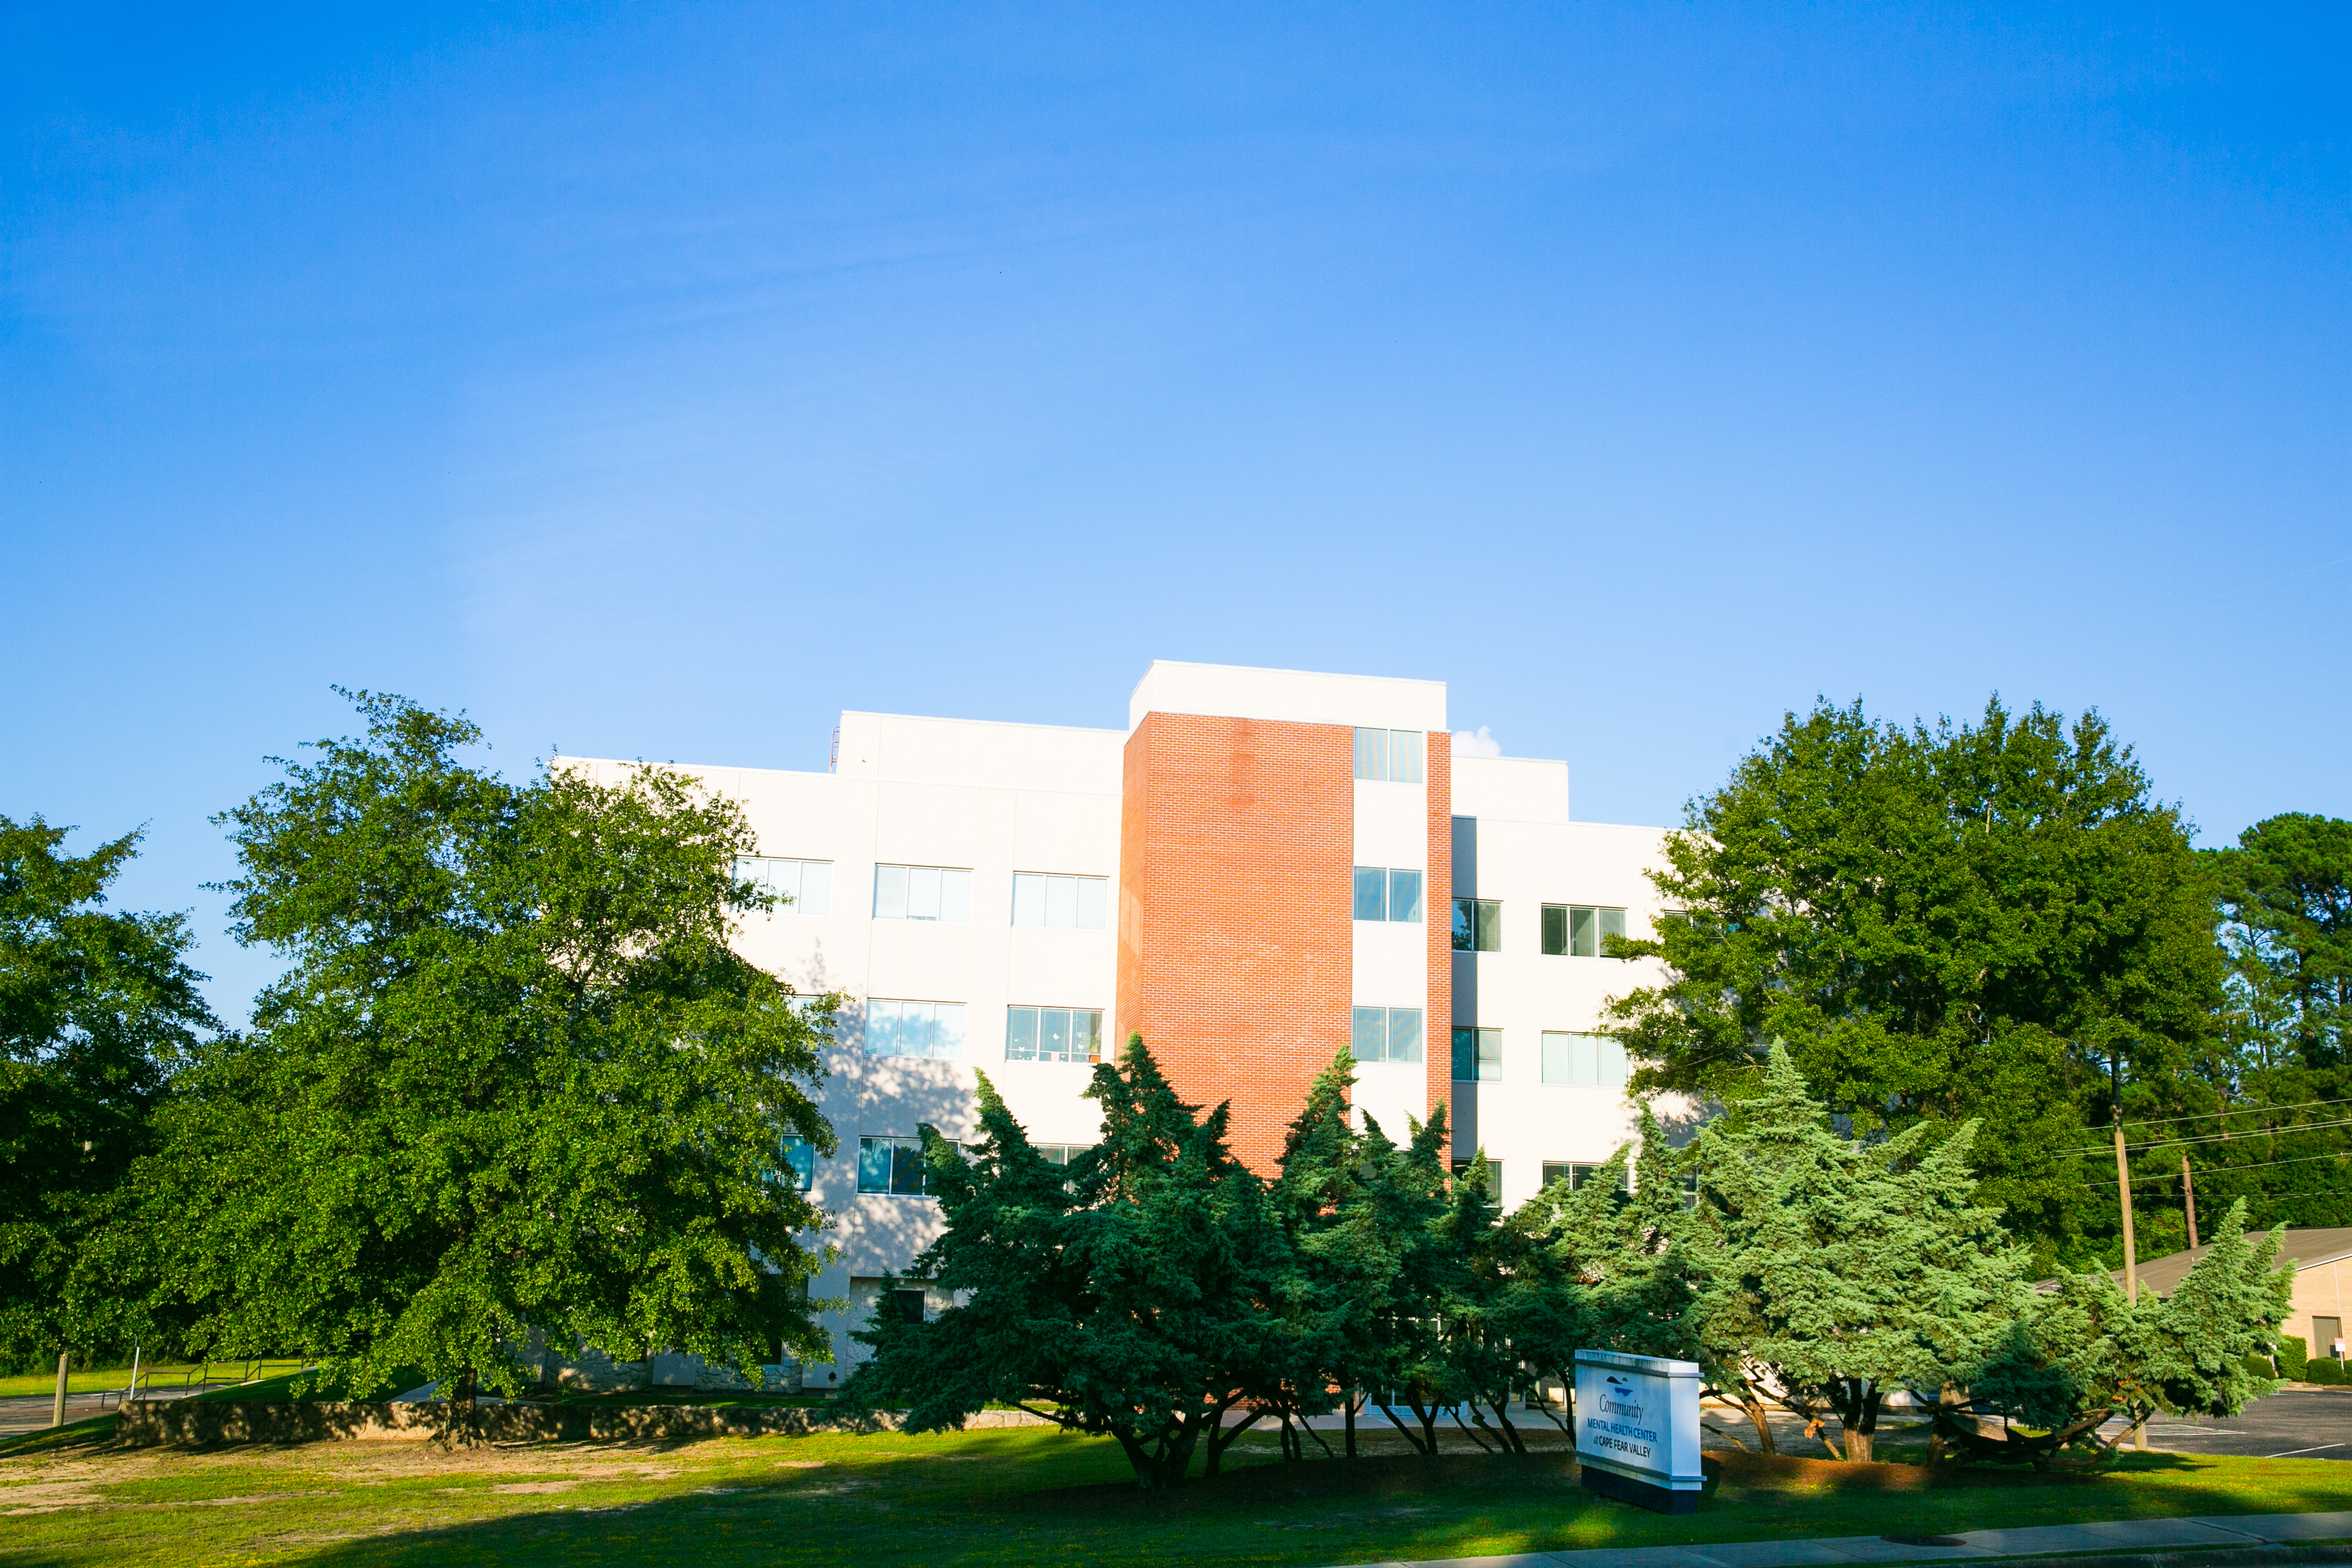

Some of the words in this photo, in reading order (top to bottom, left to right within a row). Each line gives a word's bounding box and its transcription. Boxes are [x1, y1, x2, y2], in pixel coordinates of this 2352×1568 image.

[1599, 1394, 1643, 1425] Community
[1588, 1418, 1610, 1432] MENTAL
[1610, 1424, 1633, 1437] HEALTH
[1633, 1428, 1657, 1443] CENTER
[1593, 1436, 1599, 1444] at
[1599, 1436, 1613, 1449] CAPE
[1614, 1439, 1628, 1452] FEAR
[1629, 1443, 1651, 1458] VALLEY
